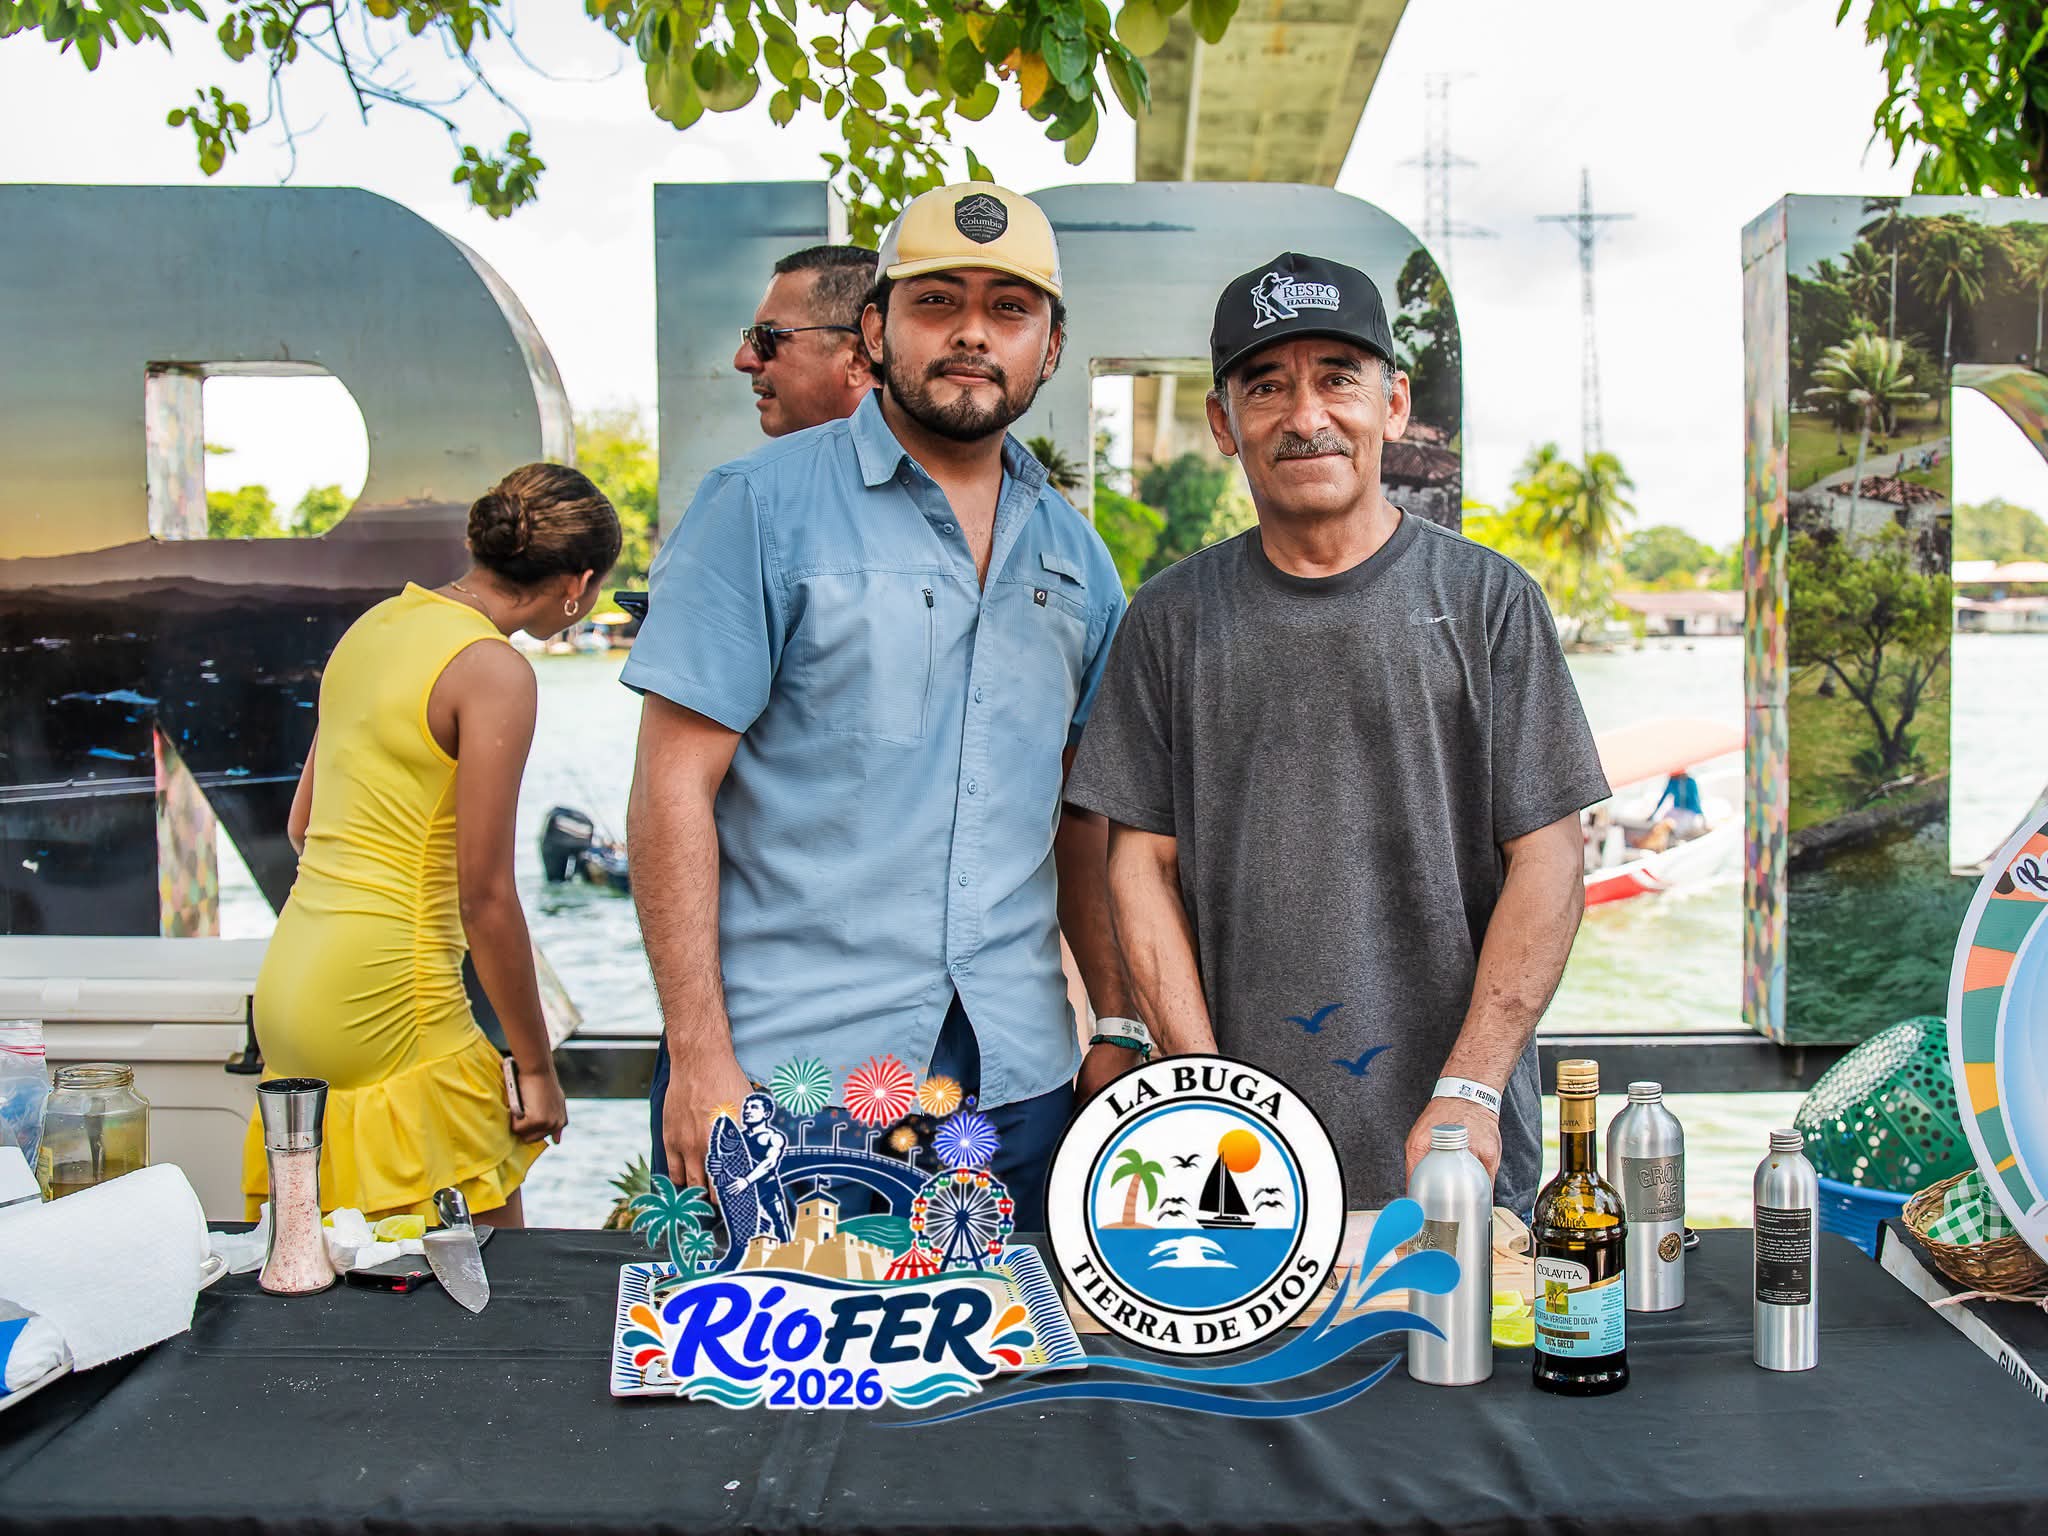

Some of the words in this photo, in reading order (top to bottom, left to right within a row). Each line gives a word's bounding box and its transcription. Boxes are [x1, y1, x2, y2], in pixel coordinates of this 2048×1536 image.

[960, 217, 1003, 229] Columbia
[1287, 299, 1336, 307] HACIENDA
[1475, 1089, 1497, 1106] FESTIVAL
[1659, 1183, 1678, 1205] 45
[1537, 1264, 1583, 1280] COLAVITA
[1550, 1314, 1573, 1325] VERGINE
[1573, 1317, 1580, 1325] DI
[1581, 1316, 1598, 1325] OLIVA
